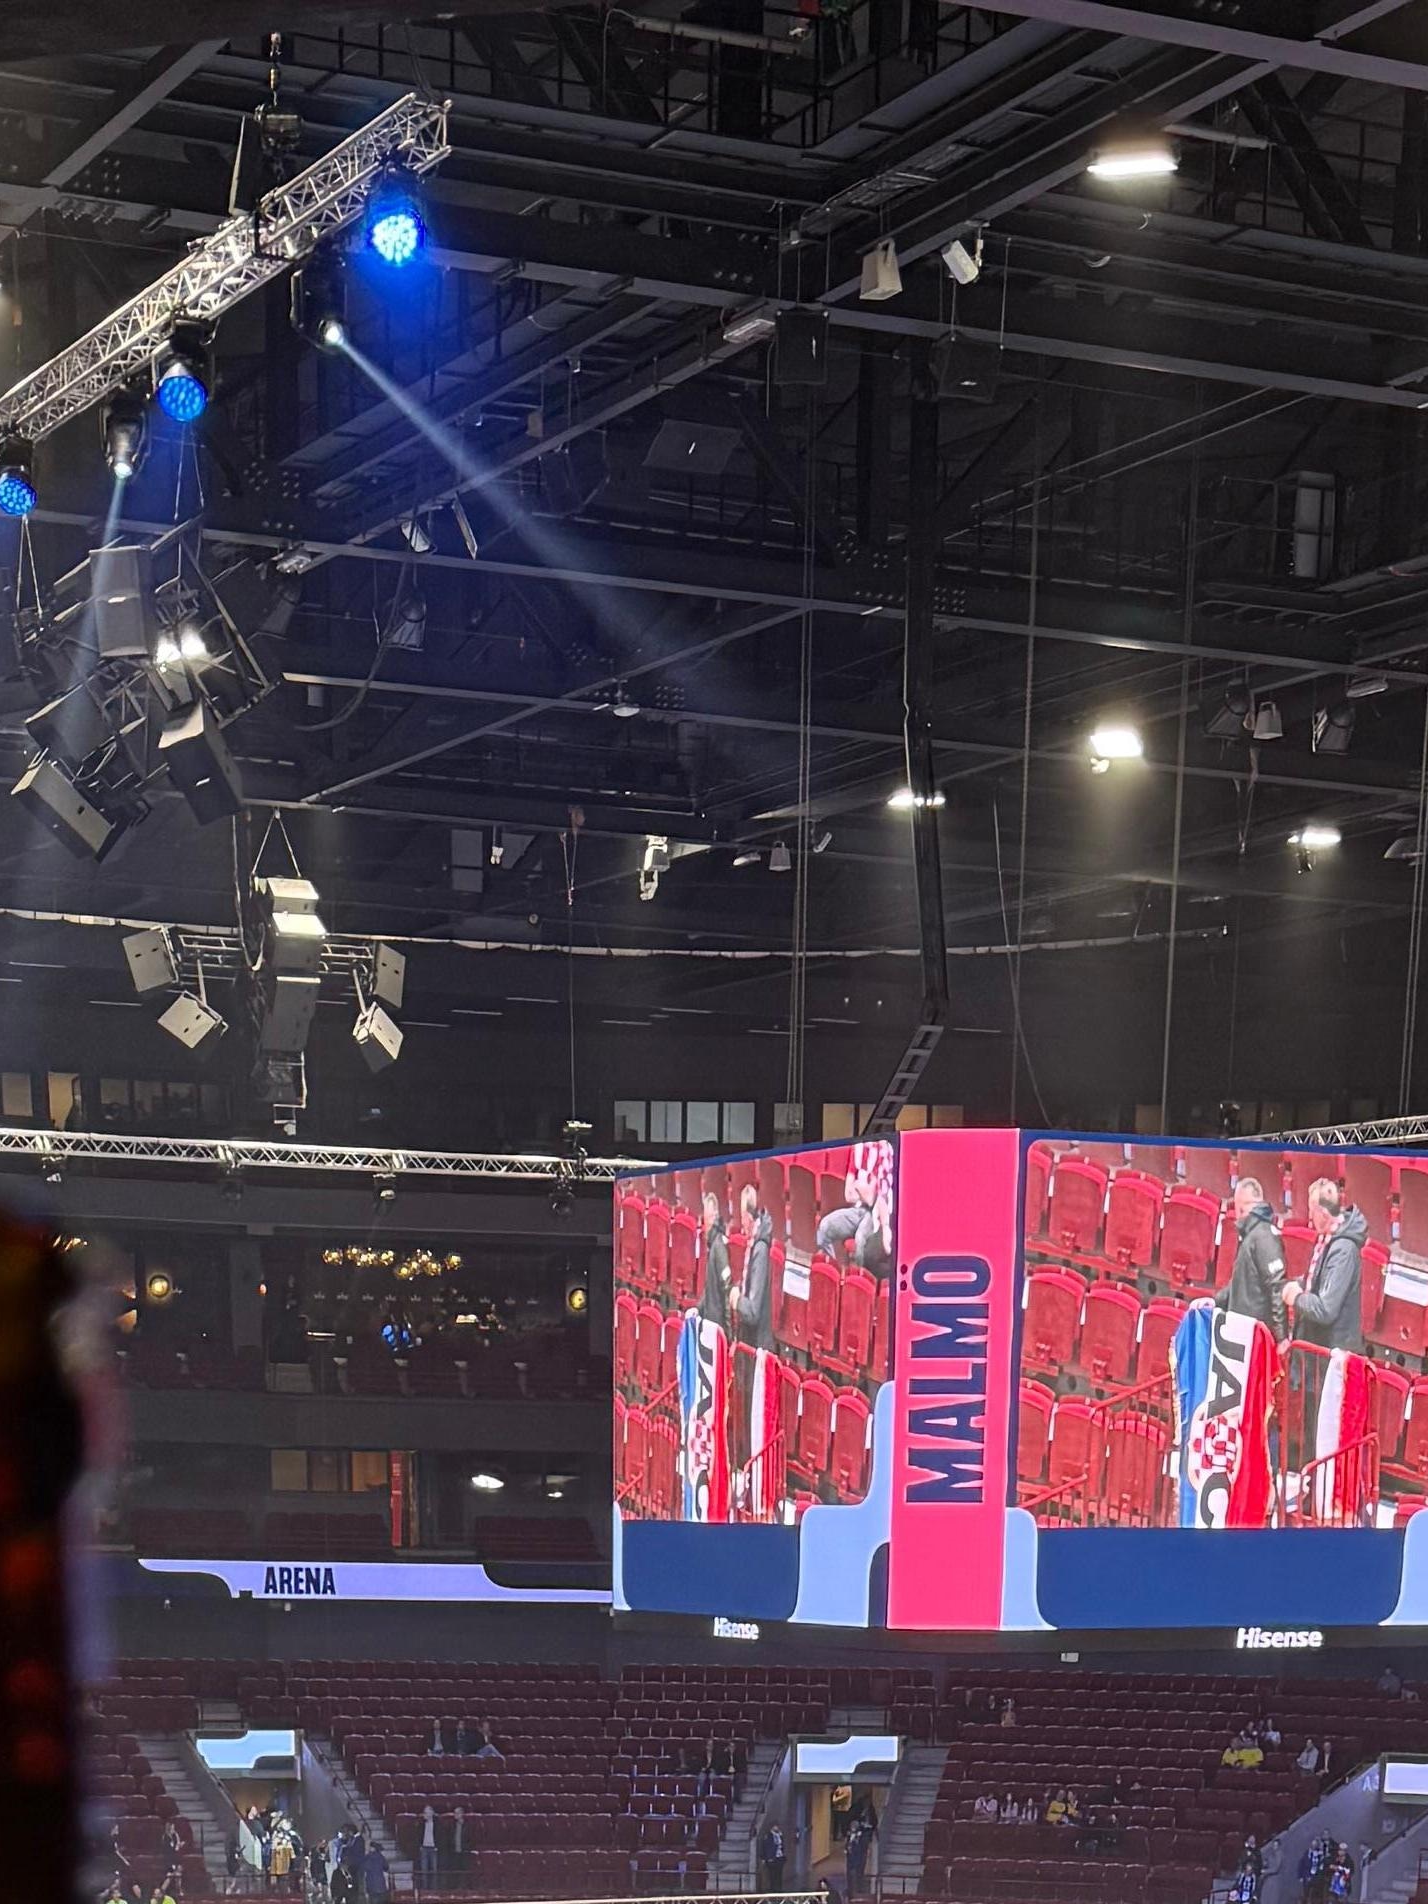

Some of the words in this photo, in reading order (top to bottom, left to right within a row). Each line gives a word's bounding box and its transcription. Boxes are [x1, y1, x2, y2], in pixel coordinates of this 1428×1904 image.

[900, 1256, 991, 1504] MALMÖ
[263, 1565, 337, 1596] ARENA
[1236, 1627, 1323, 1649] Hisense
